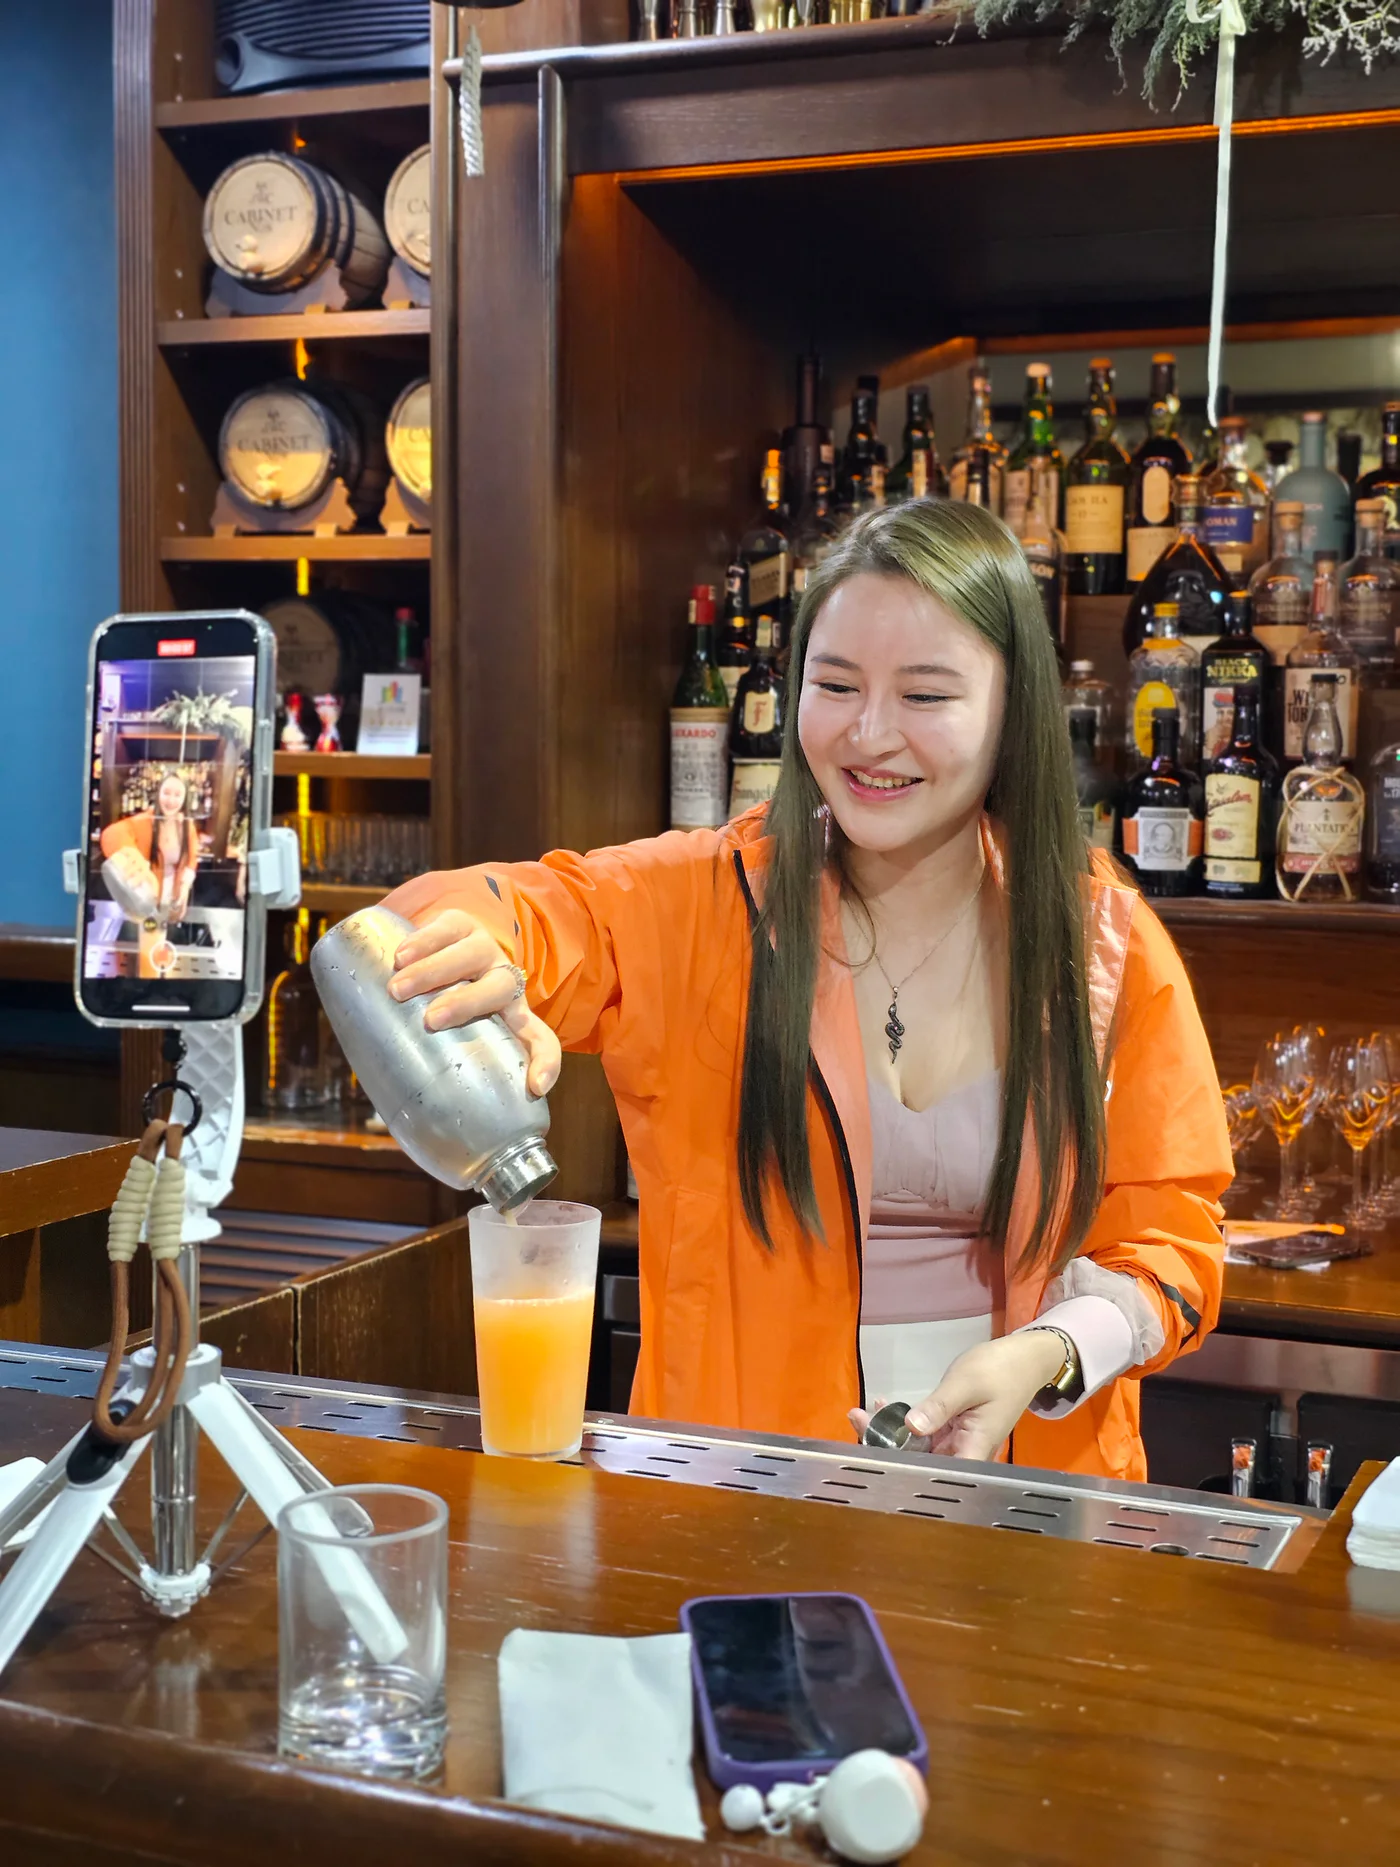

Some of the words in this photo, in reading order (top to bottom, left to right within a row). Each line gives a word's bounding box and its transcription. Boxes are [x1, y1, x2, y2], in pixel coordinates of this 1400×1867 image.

[224, 206, 298, 226] CABINET
[237, 434, 312, 453] CABINET
[1206, 664, 1258, 677] NIKKA
